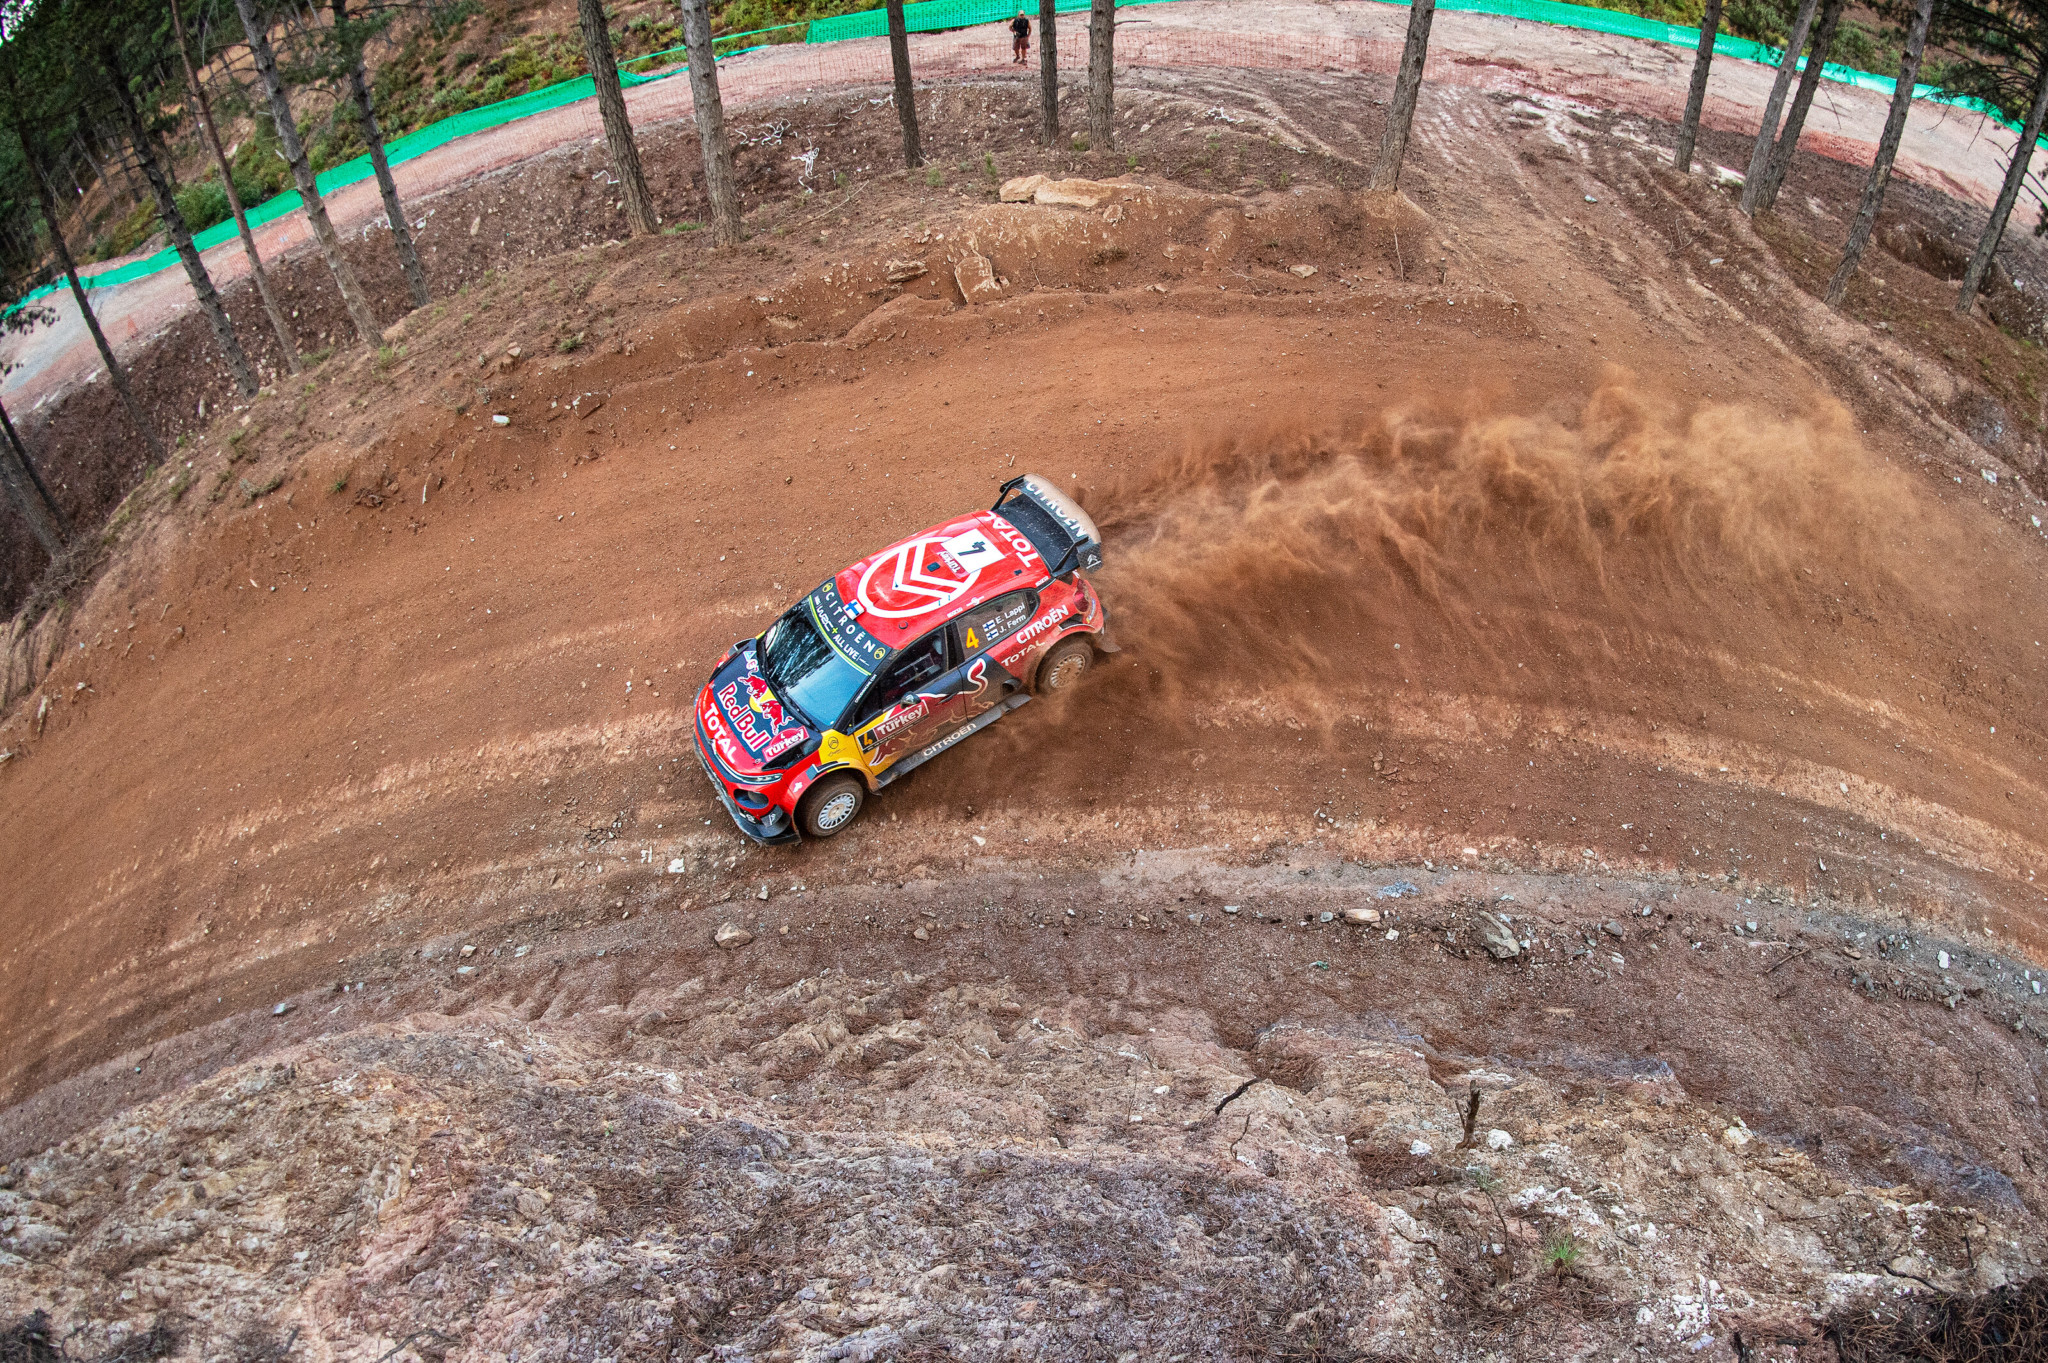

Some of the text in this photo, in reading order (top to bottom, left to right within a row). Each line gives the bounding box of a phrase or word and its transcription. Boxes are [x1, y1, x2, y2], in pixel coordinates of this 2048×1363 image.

[957, 541, 986, 556] 4
[981, 510, 1039, 568] TOTAL
[825, 592, 876, 653] CITROËN
[1004, 602, 1026, 619] Lappi
[1006, 614, 1026, 629] Ferm
[1016, 604, 1069, 644] CITROËN
[966, 627, 979, 649] 4
[1001, 640, 1045, 666] TOTAL
[704, 703, 737, 763] TOTAL
[923, 722, 977, 757] CITROËN
